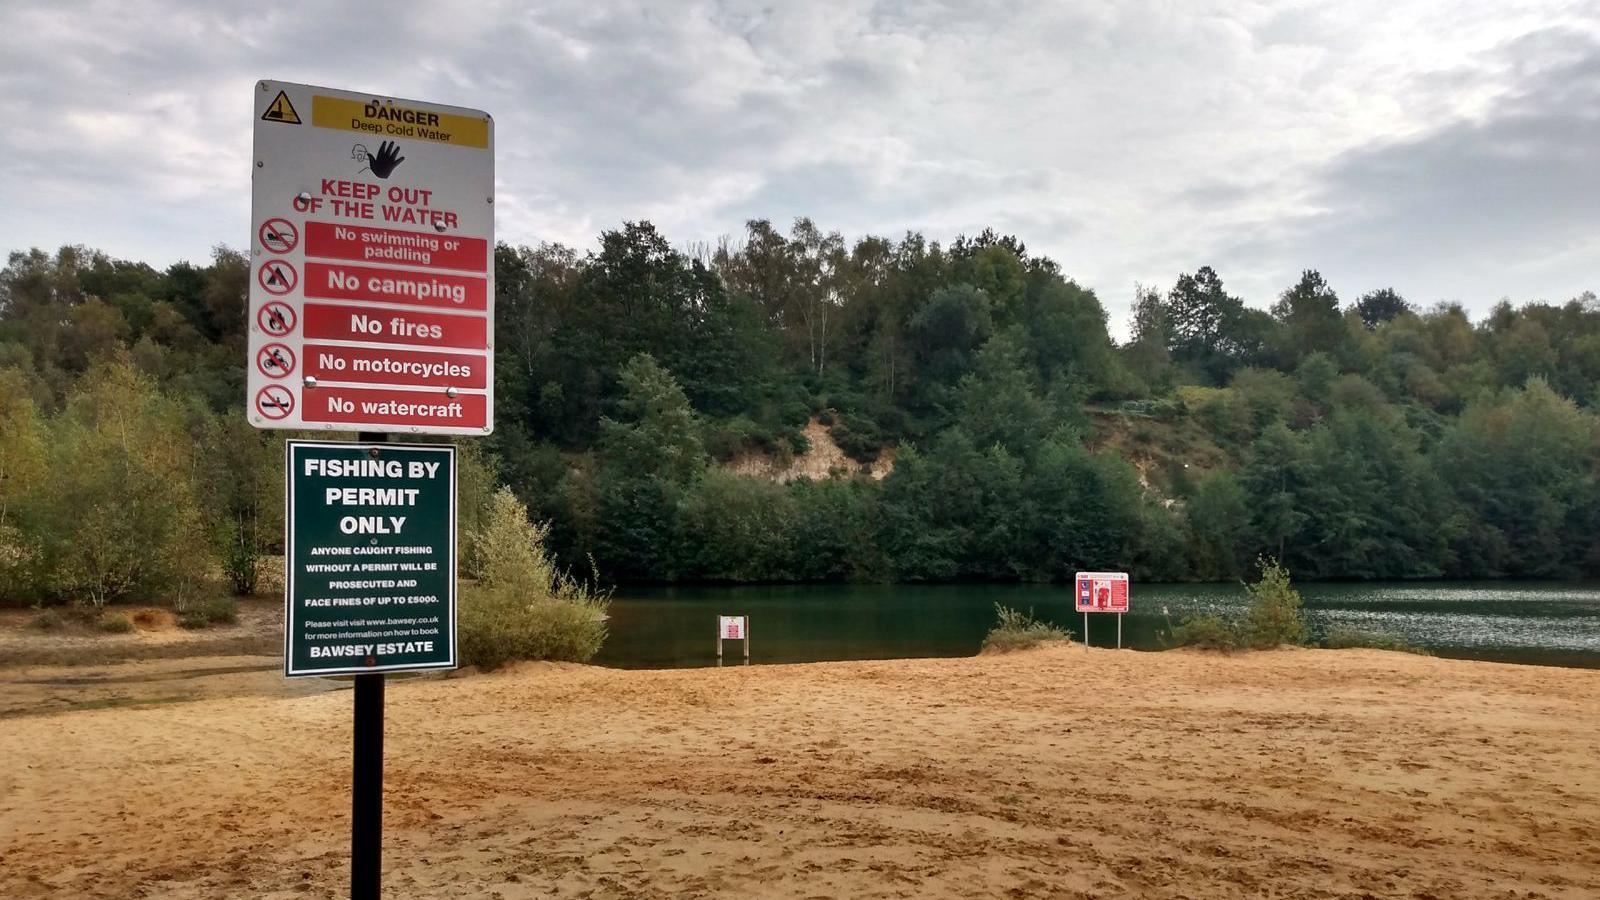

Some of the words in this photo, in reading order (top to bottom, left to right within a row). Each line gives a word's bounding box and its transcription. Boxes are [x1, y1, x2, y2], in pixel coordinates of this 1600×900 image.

[365, 104, 438, 127] DANGER
[352, 119, 382, 133] Deep
[387, 125, 413, 137] Cold
[418, 128, 451, 141] Water
[322, 179, 380, 200] KEEP
[388, 187, 432, 206] OUT
[293, 196, 323, 213] OF
[331, 200, 374, 219] THE
[382, 205, 457, 228] WATER
[335, 227, 356, 241] No
[362, 232, 438, 251] swimming
[444, 240, 459, 250] or
[365, 246, 431, 264] paddling
[328, 271, 360, 290] No
[368, 277, 465, 302] camping
[351, 315, 382, 334] No
[390, 318, 442, 338] fires
[319, 354, 346, 370] No
[353, 358, 471, 377] motorcycles
[328, 397, 354, 413] No
[362, 401, 462, 417] watercraft
[305, 459, 402, 477] FISHING
[409, 462, 440, 478] BY
[326, 488, 419, 505] PERMIT
[340, 517, 406, 534] ONLY
[311, 547, 351, 555] ANYONE
[306, 564, 351, 572] WITHOUT
[329, 581, 395, 589] PROSECUTED
[333, 598, 361, 606] FINES
[377, 597, 391, 605] UP
[408, 596, 439, 604] £5000.
[367, 616, 439, 626] www.bawsey.co.uk
[339, 631, 382, 639] information
[310, 645, 374, 658] BAWSEY
[377, 642, 433, 654] ESTATE
